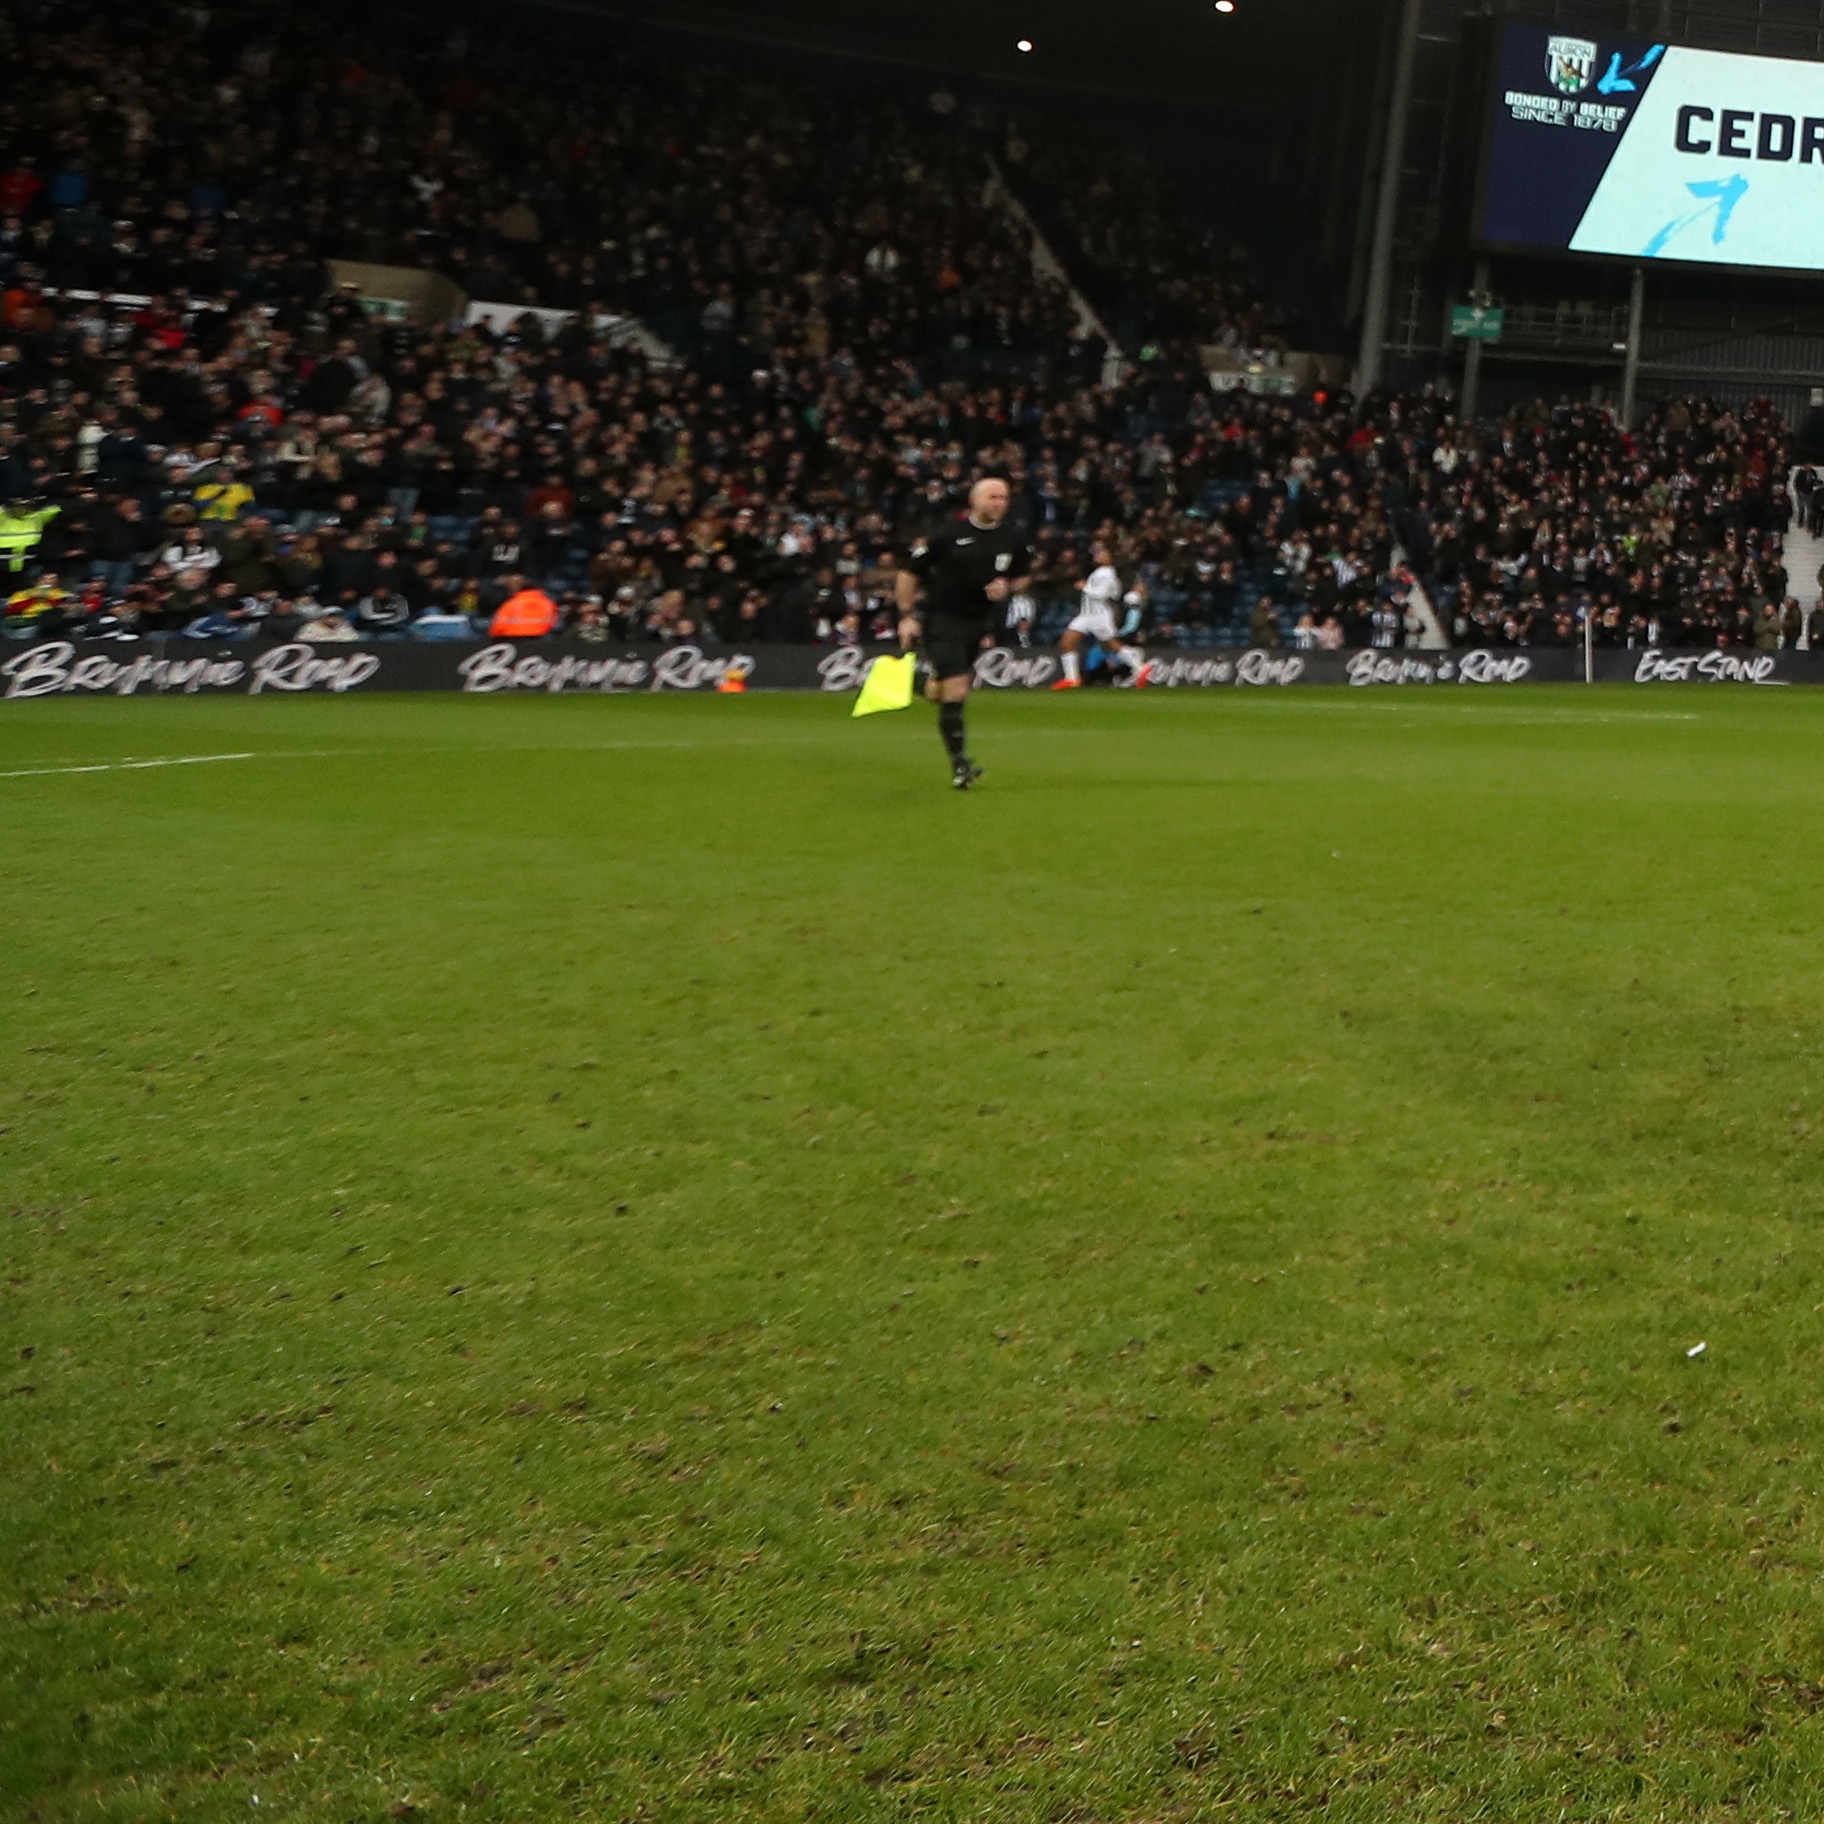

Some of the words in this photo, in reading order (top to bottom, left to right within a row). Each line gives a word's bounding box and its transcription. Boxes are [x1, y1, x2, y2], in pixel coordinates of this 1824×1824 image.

[1505, 91, 1560, 111] BONDED
[1561, 100, 1577, 114] BY
[1579, 102, 1628, 120] BELIEF
[1511, 106, 1567, 127] SINCE
[1634, 650, 1699, 683] EAST
[1697, 650, 1779, 683] STAND
